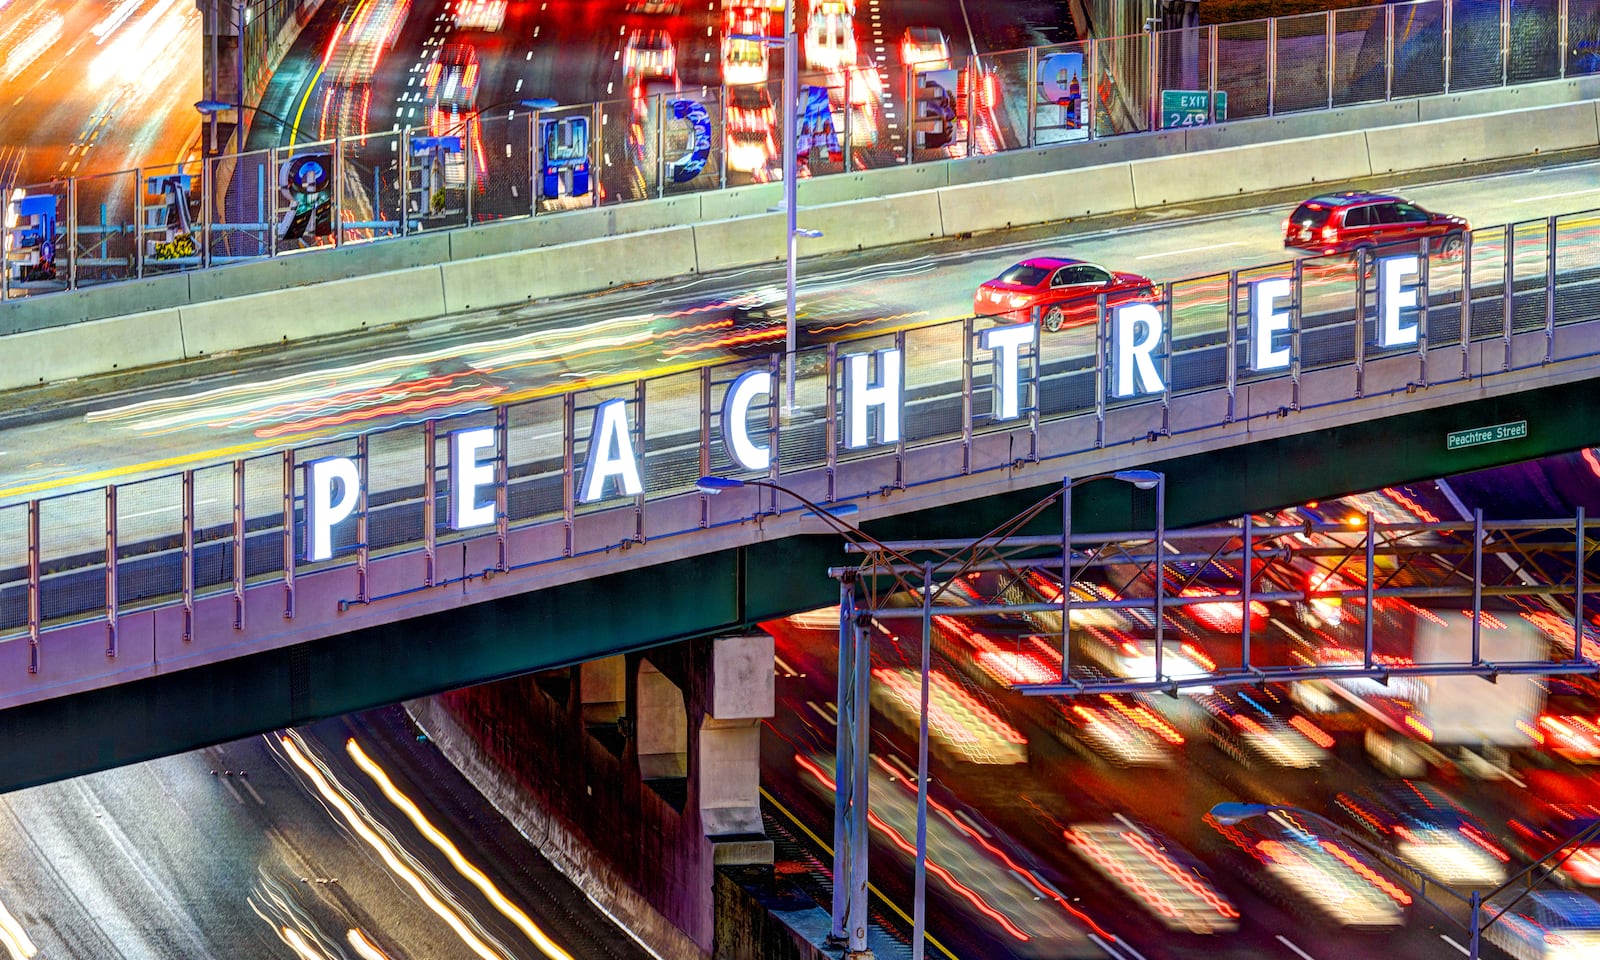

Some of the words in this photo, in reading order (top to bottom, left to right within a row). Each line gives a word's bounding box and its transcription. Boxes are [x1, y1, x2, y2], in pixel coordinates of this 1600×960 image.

[1181, 96, 1207, 107] EXIT
[306, 254, 1419, 562] PEACHTREE
[1449, 431, 1492, 447] Peachtree
[1496, 423, 1525, 438] Street
